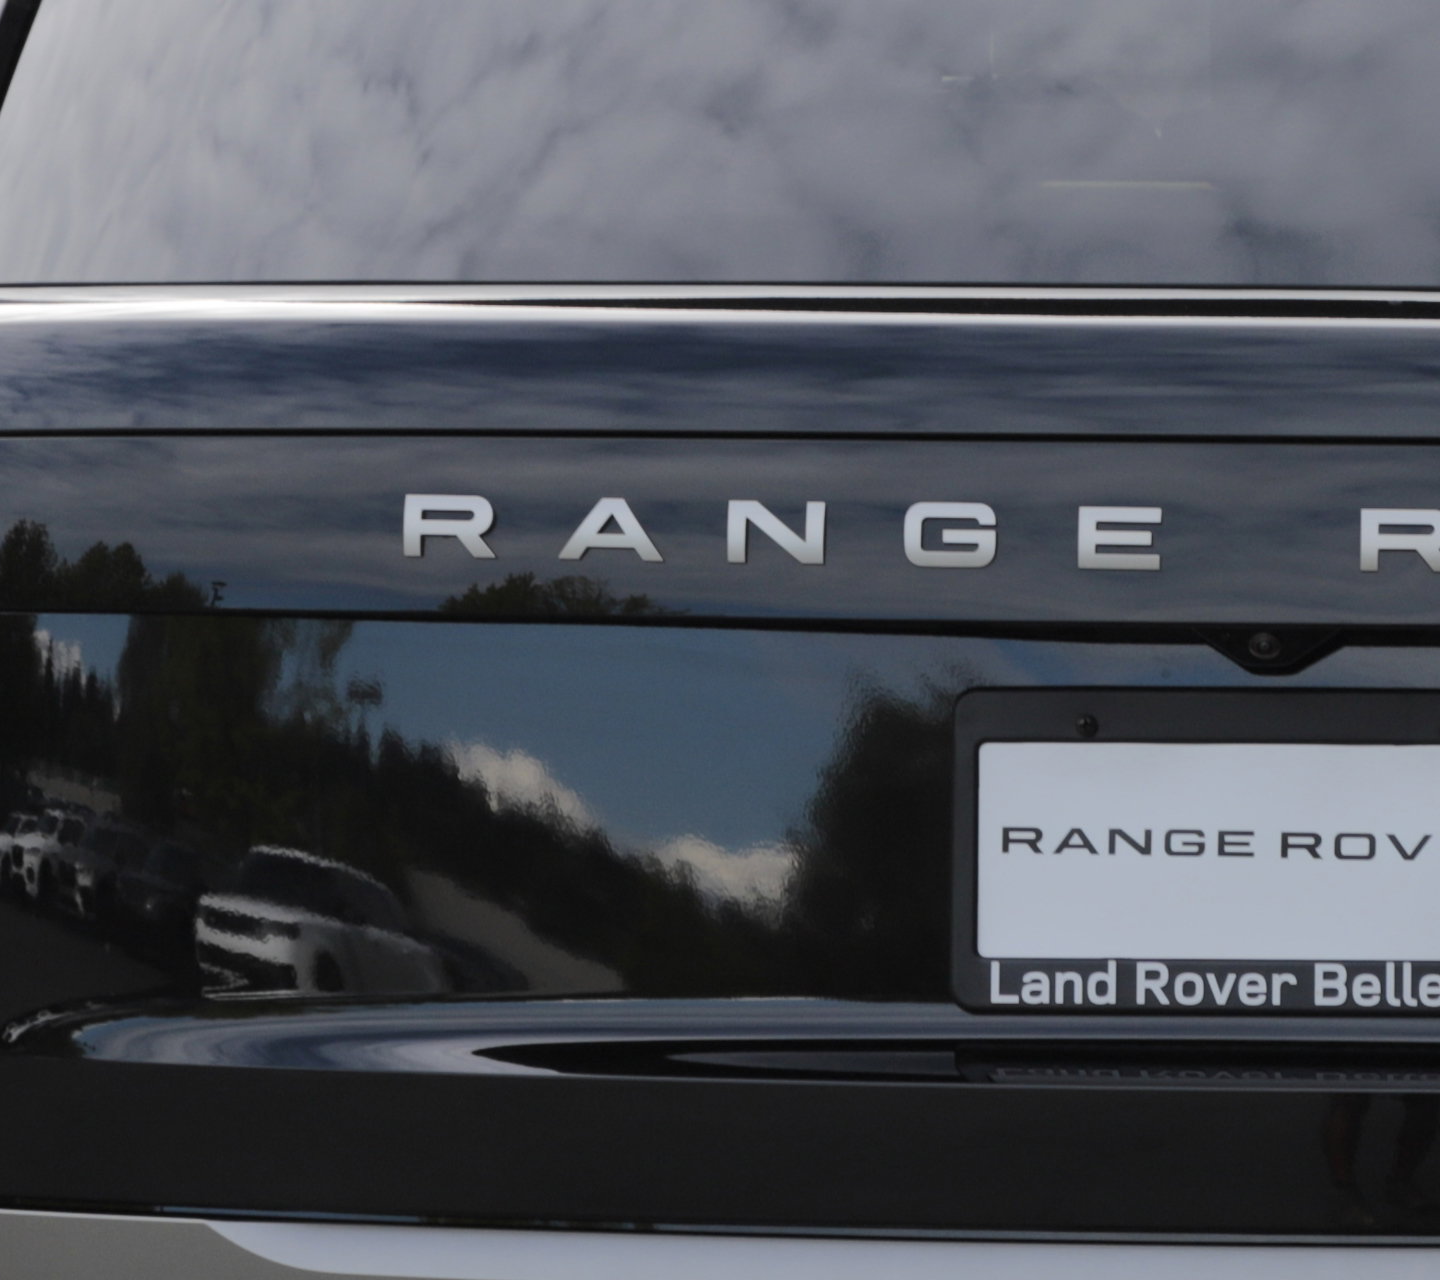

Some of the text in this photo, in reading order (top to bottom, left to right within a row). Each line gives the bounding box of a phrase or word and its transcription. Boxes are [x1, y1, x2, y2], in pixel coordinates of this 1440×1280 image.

[402, 493, 1163, 571] RANGE
[1002, 827, 1255, 857] RANGE
[989, 960, 1117, 1005] Land
[1137, 963, 1297, 1007] Rover
